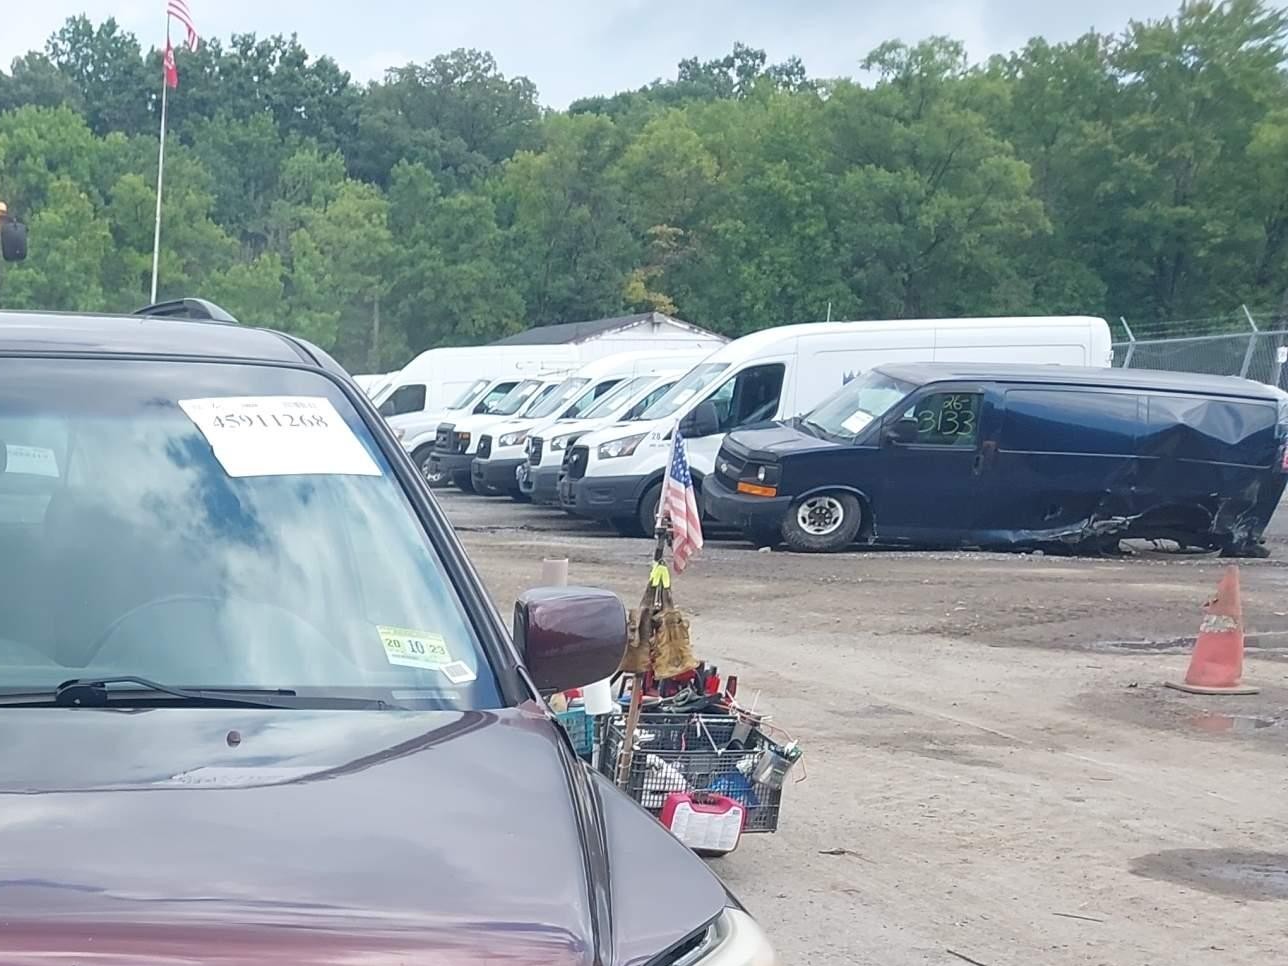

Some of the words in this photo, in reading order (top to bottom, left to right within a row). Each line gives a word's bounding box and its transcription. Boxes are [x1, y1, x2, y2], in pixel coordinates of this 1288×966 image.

[213, 413, 329, 428] 45911268
[918, 410, 975, 435] 3133
[408, 639, 425, 655] 10
